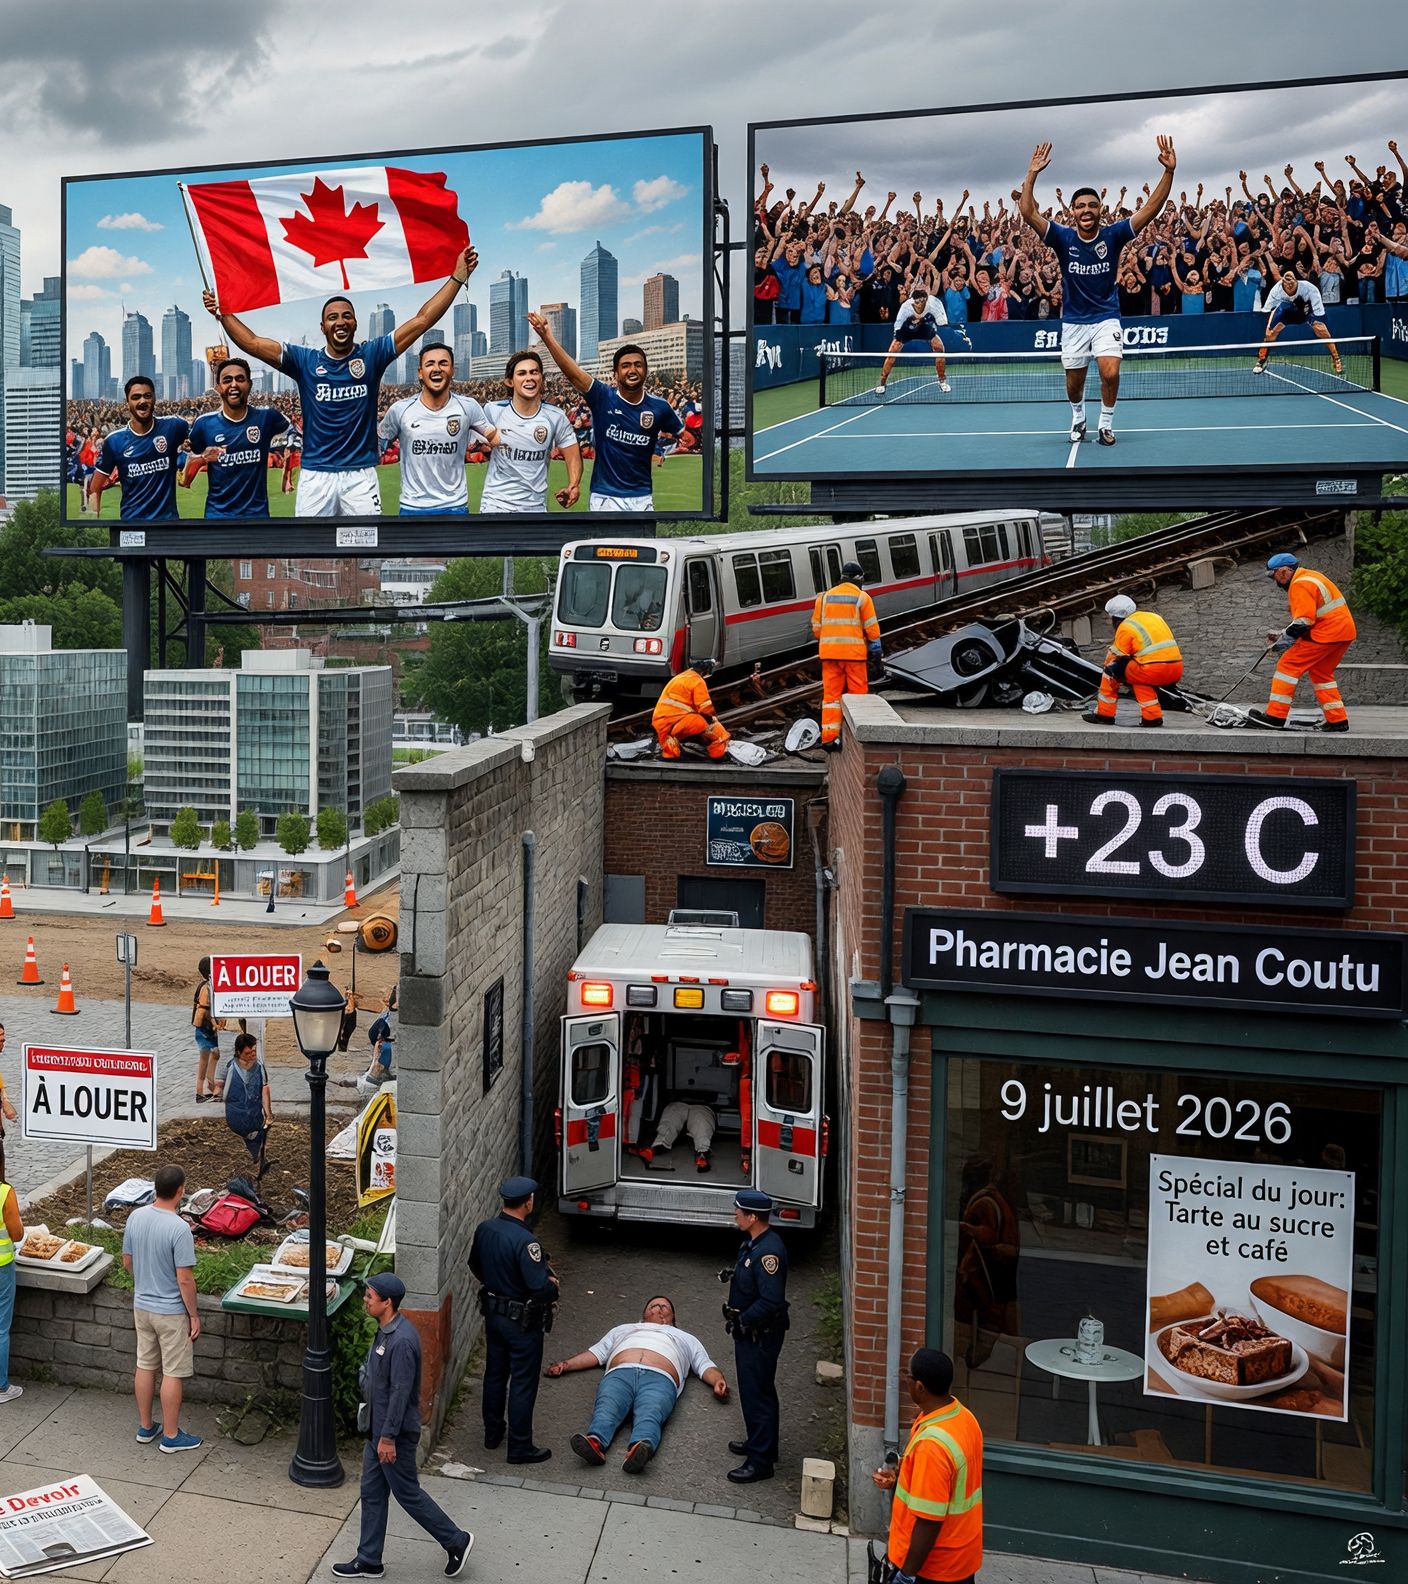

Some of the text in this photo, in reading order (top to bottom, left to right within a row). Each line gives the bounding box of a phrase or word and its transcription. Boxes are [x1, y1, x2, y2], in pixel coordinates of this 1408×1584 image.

[1024, 790, 1320, 884] +23 C
[217, 960, 296, 987] À LOUER
[929, 928, 1380, 991] Pharmacie Jean Coutu
[32, 1075, 147, 1123] À LOUER
[1000, 1080, 1293, 1144] 9 juillet 2026
[1157, 1169, 1347, 1211] Spécial du jour:
[1164, 1202, 1335, 1238] Tarte au sucre
[1206, 1236, 1289, 1263] et café
[6, 1483, 80, 1512] Devoir
